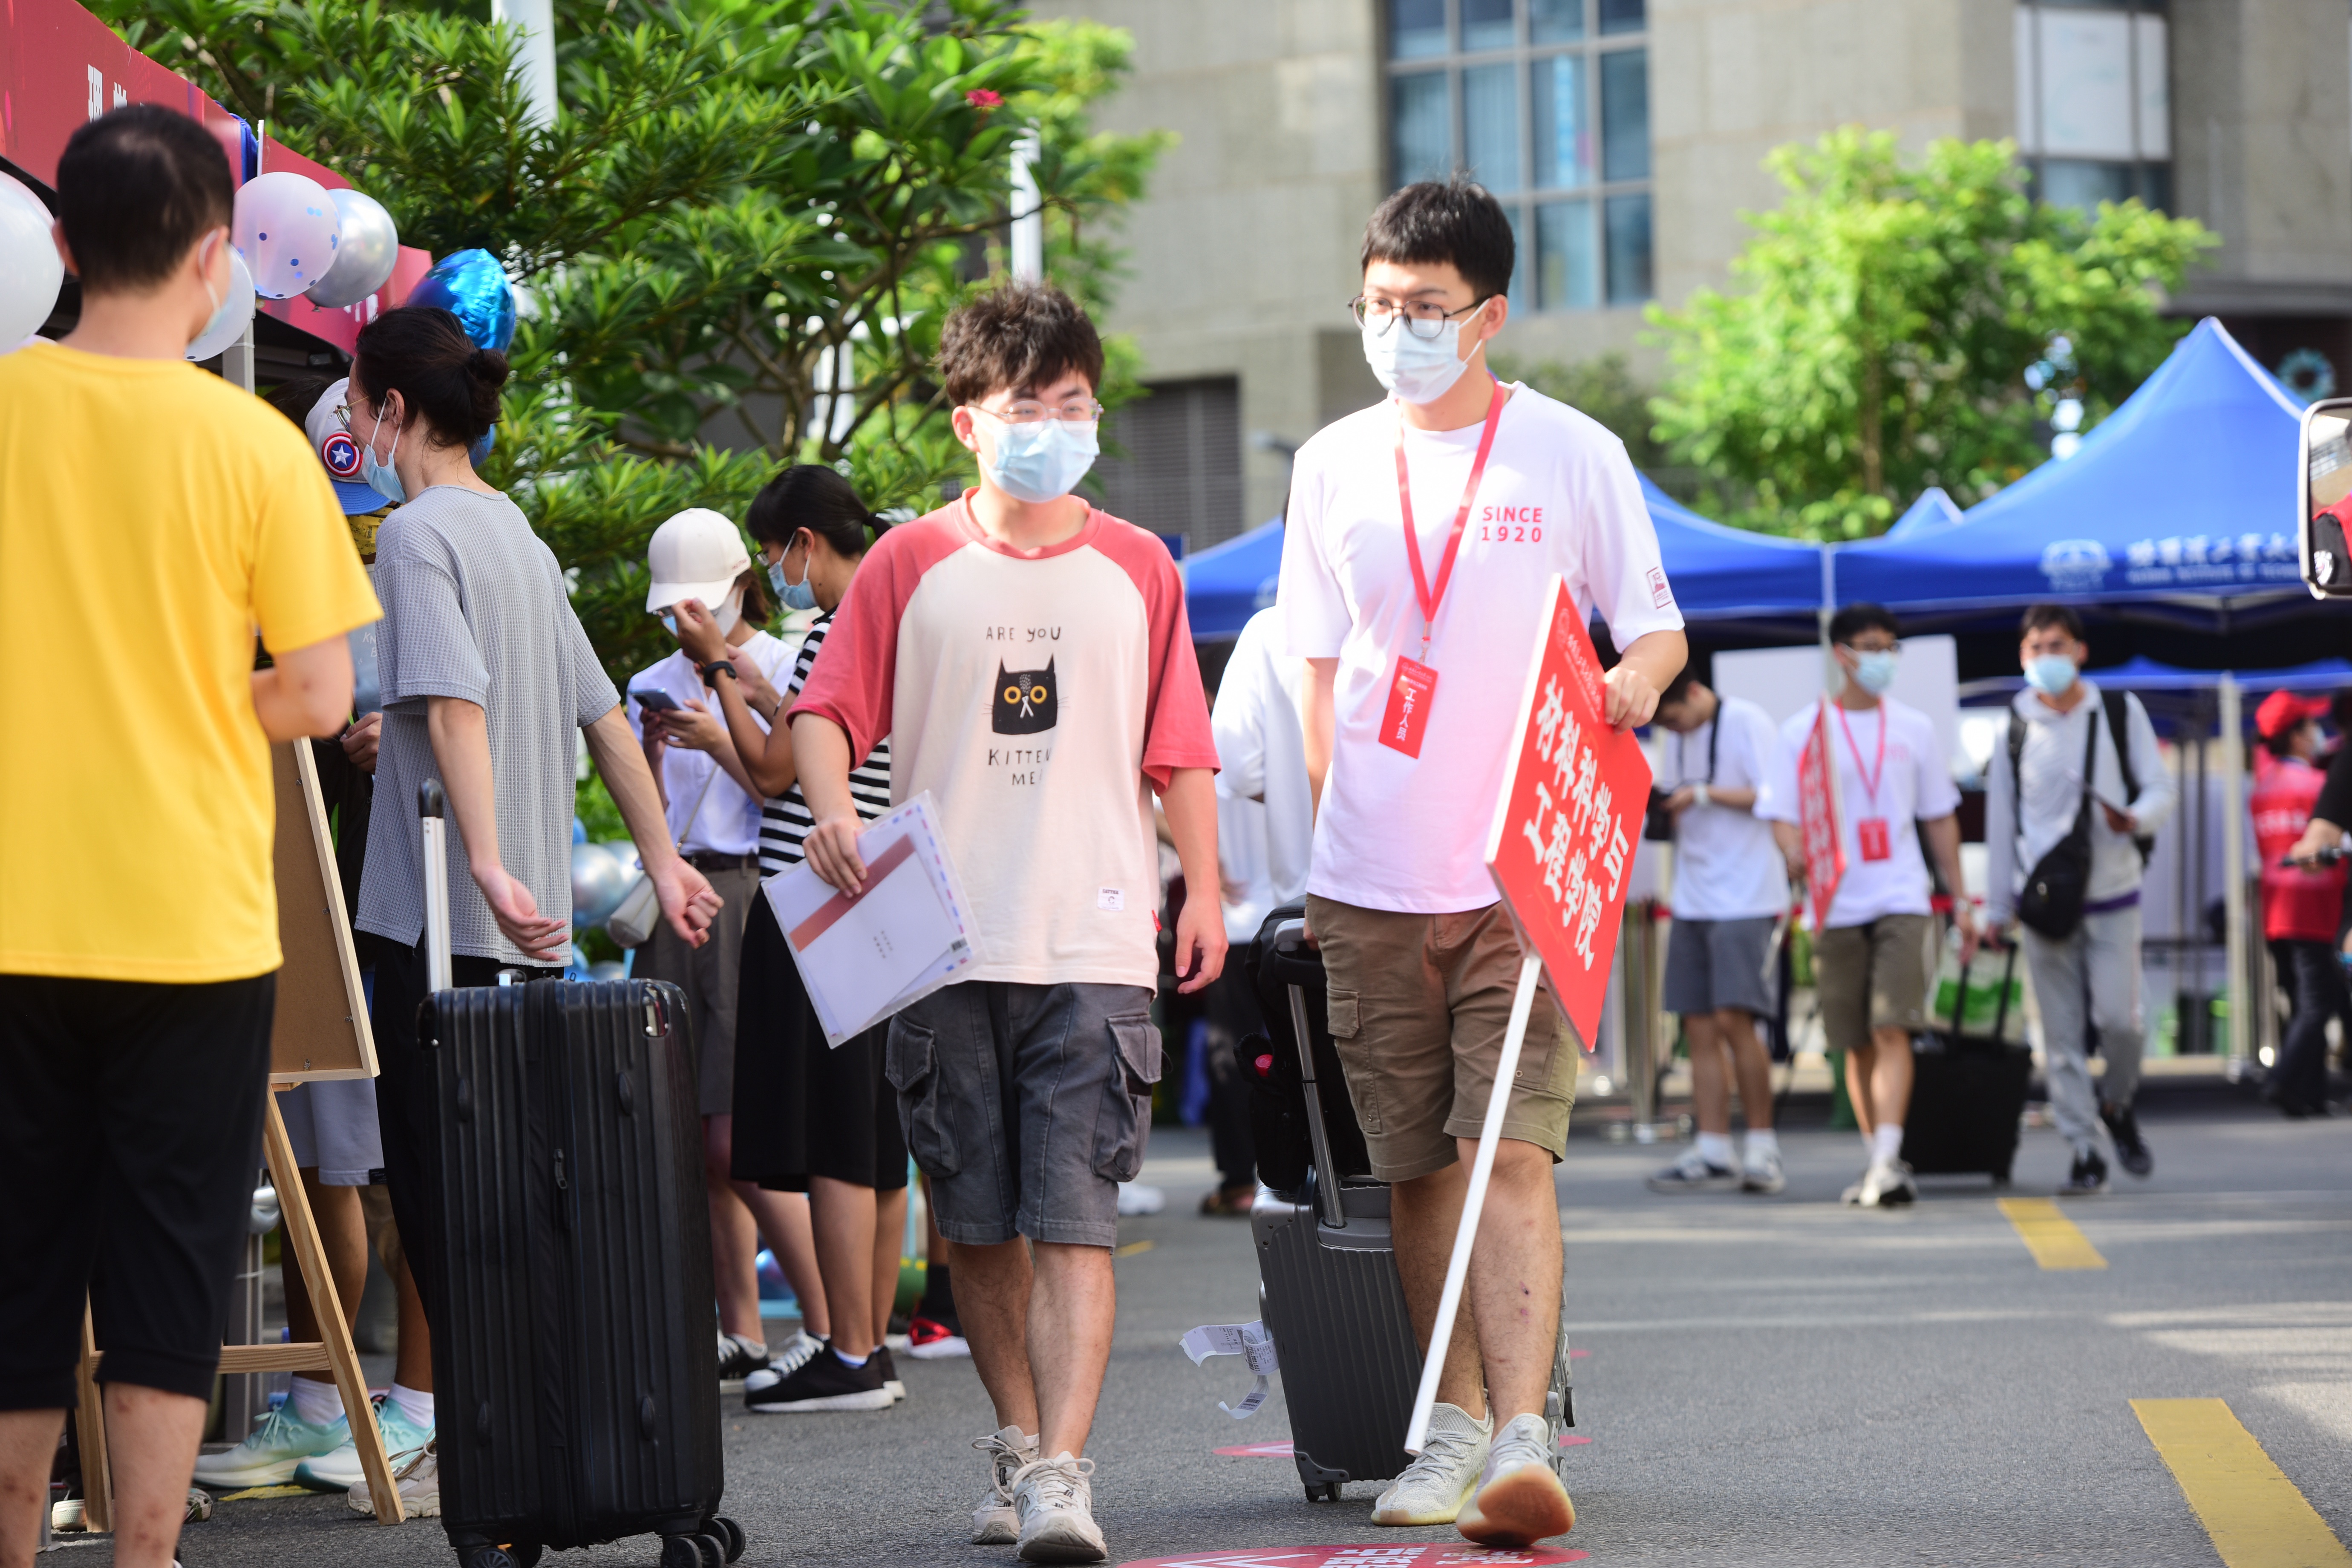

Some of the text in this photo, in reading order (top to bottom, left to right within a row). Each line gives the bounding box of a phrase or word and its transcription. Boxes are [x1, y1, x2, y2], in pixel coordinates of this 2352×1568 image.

[1483, 506, 1543, 522] SINCE
[1482, 525, 1542, 542] 1920
[986, 626, 1015, 640] ARE
[1396, 687, 1417, 741] 工作人员
[988, 747, 1052, 766] KITTEN
[1536, 672, 1629, 903] 材料科学与
[1522, 781, 1603, 971] 工程学院
